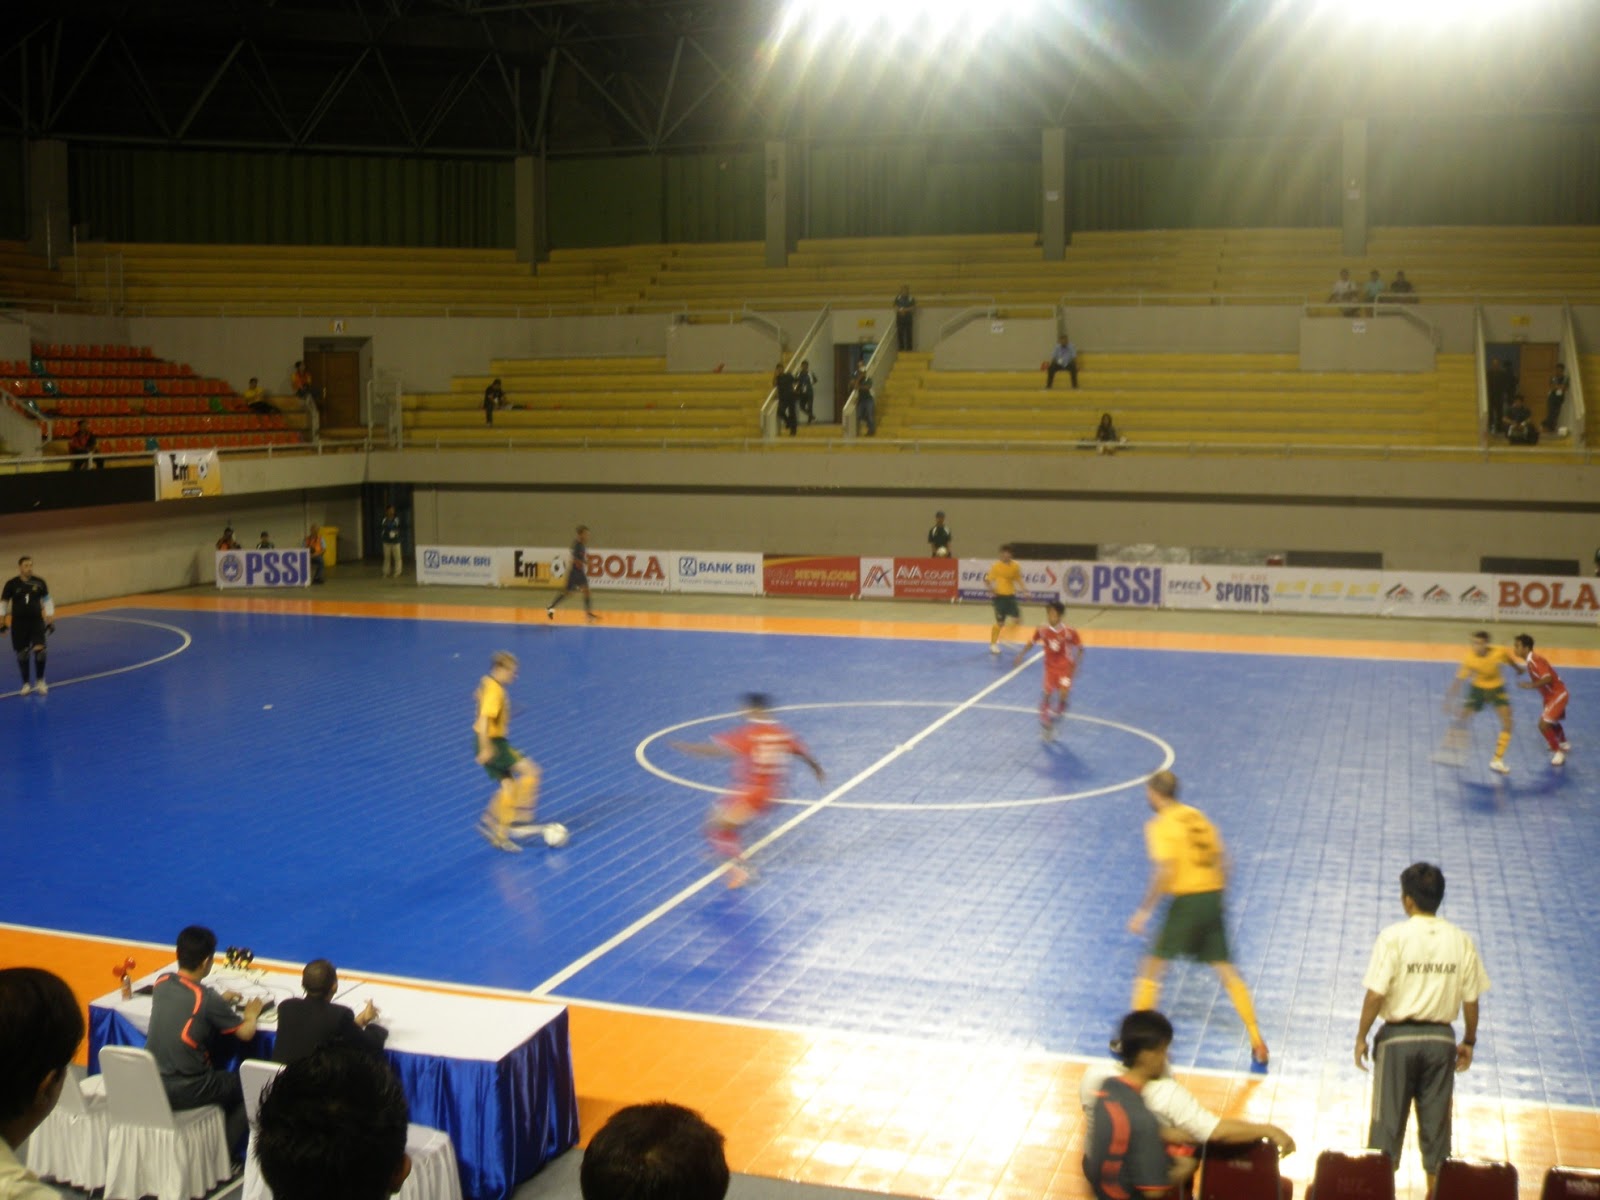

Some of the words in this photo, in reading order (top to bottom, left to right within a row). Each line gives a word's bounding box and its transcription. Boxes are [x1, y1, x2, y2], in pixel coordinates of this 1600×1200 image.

[245, 551, 307, 585] PSSI
[441, 555, 470, 566] BANK
[473, 556, 490, 567] BRI
[586, 554, 665, 580] BOLA
[698, 562, 732, 574] BANK
[735, 563, 755, 574] BRI
[895, 565, 923, 579] AVA
[1092, 565, 1162, 604] PSSI
[1168, 580, 1201, 590] SPECS
[1216, 582, 1269, 604] SPORTS
[1498, 581, 1600, 610] BOLA
[1407, 962, 1456, 975] MYANMAR
